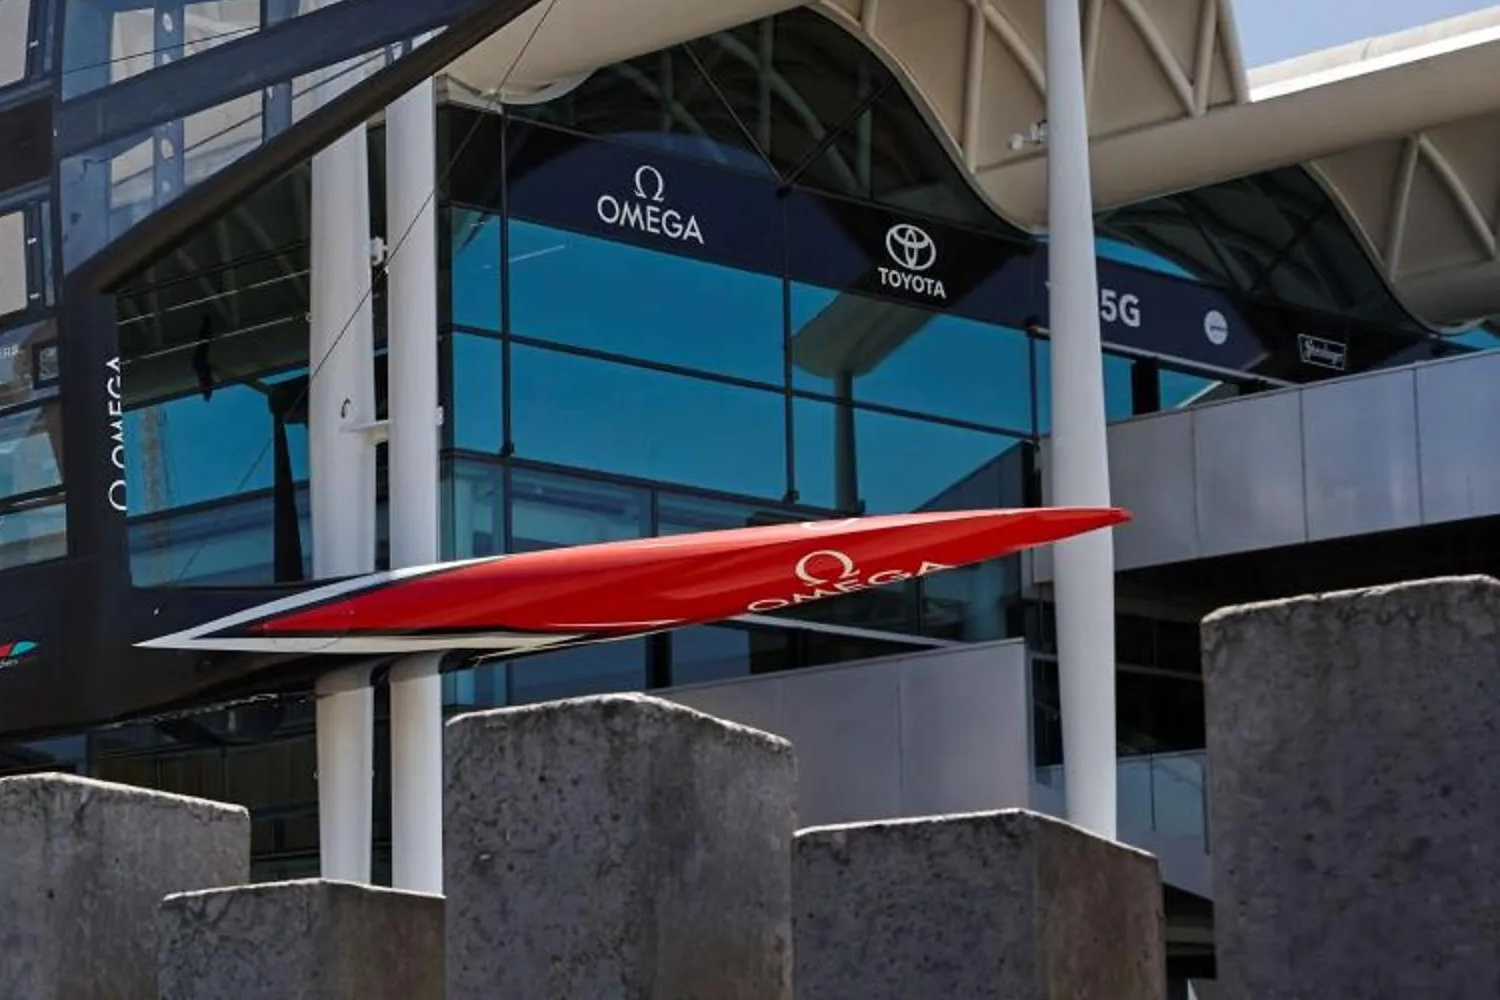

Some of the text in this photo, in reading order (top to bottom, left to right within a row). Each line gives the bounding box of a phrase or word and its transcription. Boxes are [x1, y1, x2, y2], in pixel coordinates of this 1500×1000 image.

[596, 194, 705, 245] OMEGA
[877, 266, 947, 299] TOYOTA
[1099, 288, 1141, 328] 5G
[748, 561, 957, 613] OMEGA
